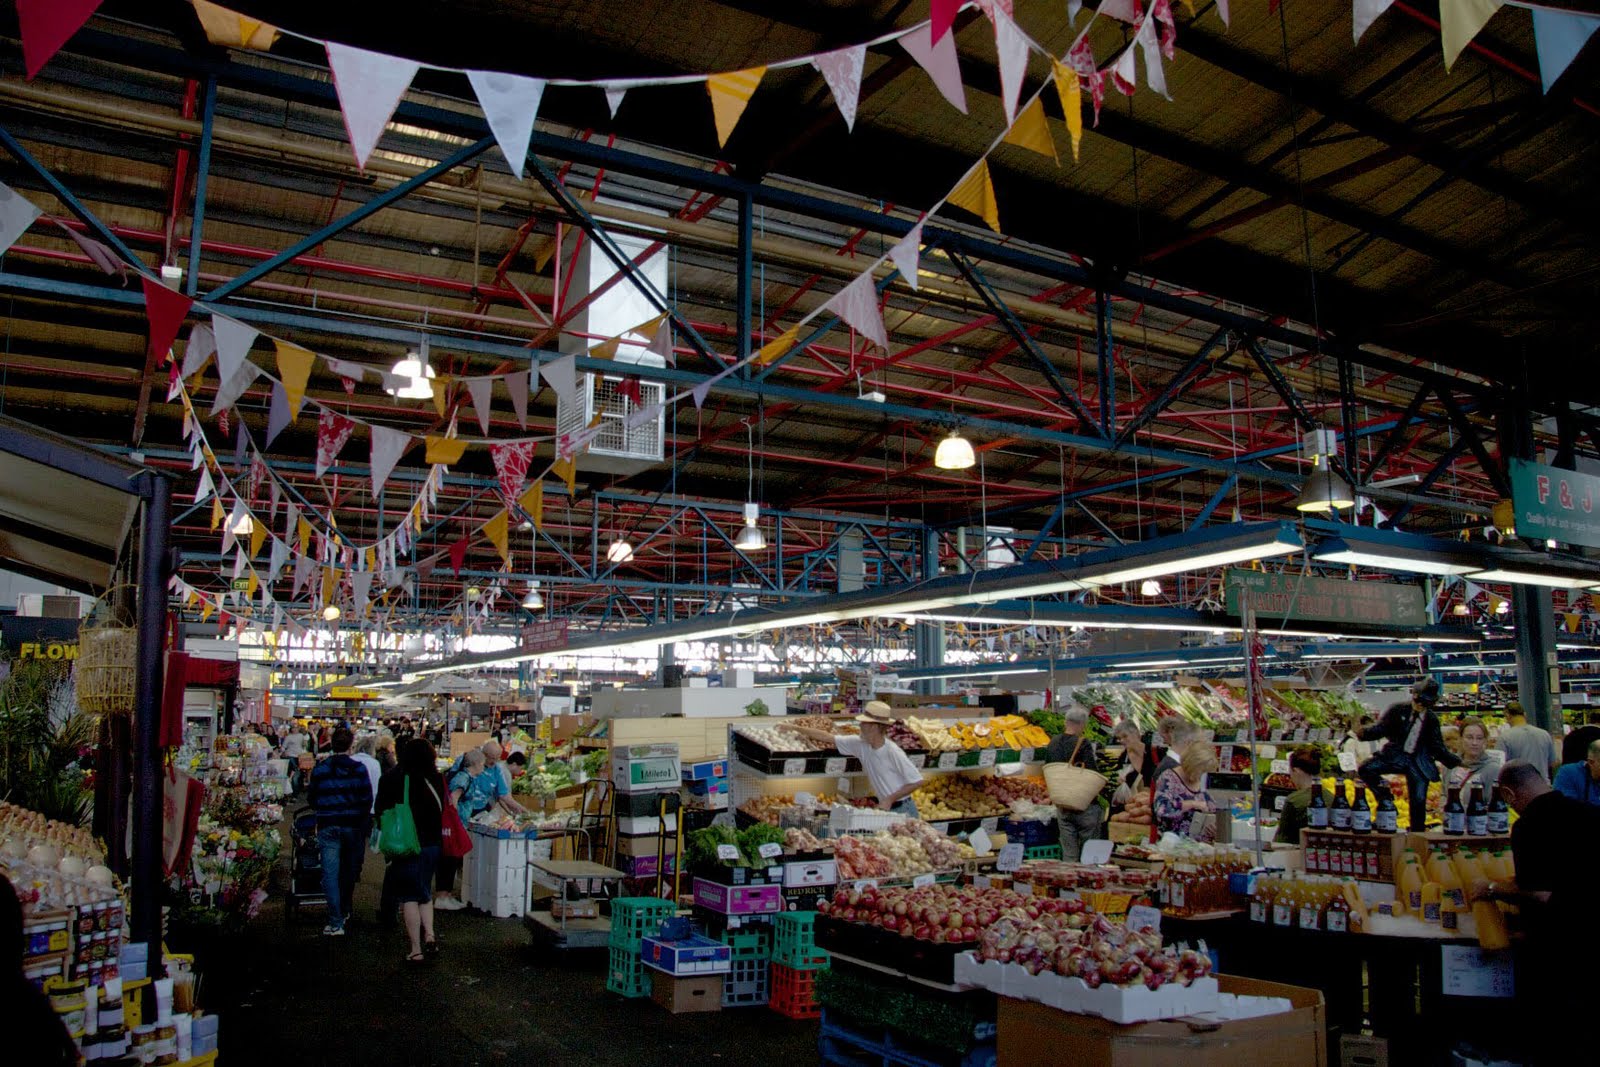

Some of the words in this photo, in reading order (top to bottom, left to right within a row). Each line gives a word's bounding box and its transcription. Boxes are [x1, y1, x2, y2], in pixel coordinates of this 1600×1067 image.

[1537, 474, 1550, 504] F
[1559, 479, 1574, 510] &
[1581, 482, 1593, 514] J
[234, 581, 249, 590] EXIT
[1238, 591, 1292, 612] QUALITY
[20, 641, 79, 660] FLOW
[644, 769, 668, 779] Mileto
[805, 886, 826, 895] RICH
